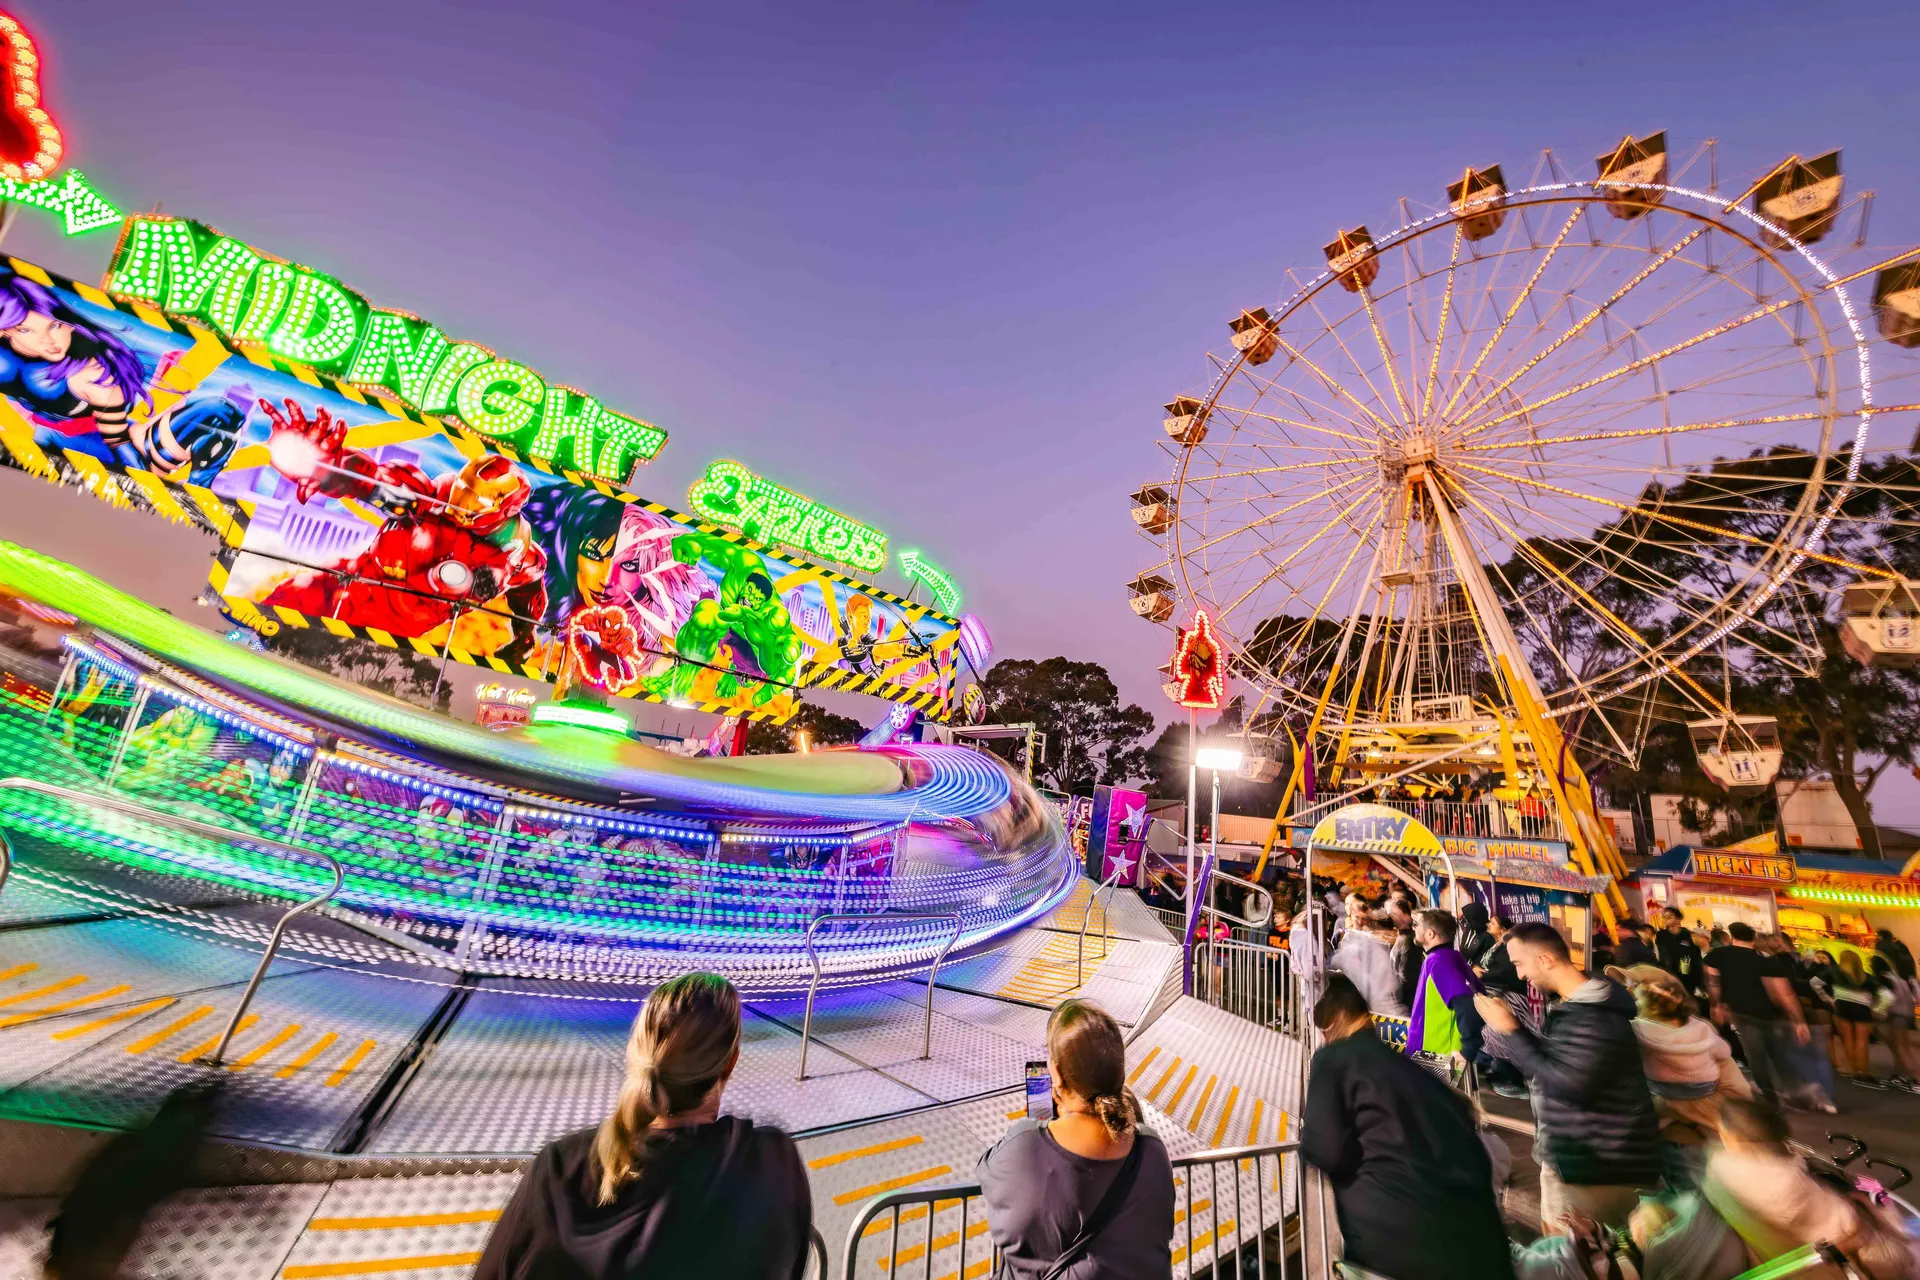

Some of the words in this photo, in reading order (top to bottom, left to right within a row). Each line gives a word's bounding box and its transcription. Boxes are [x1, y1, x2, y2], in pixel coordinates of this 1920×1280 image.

[1335, 815, 1409, 844] ENTRY
[1444, 839, 1478, 857] BIG
[1486, 843, 1554, 863] WHEEL
[1695, 855, 1795, 882] TICKETS
[1501, 894, 1518, 906] take
[1519, 896, 1525, 905] a
[1526, 893, 1540, 906] trip
[1511, 905, 1519, 914] to
[1521, 904, 1534, 914] the
[1525, 911, 1546, 923] zone!
